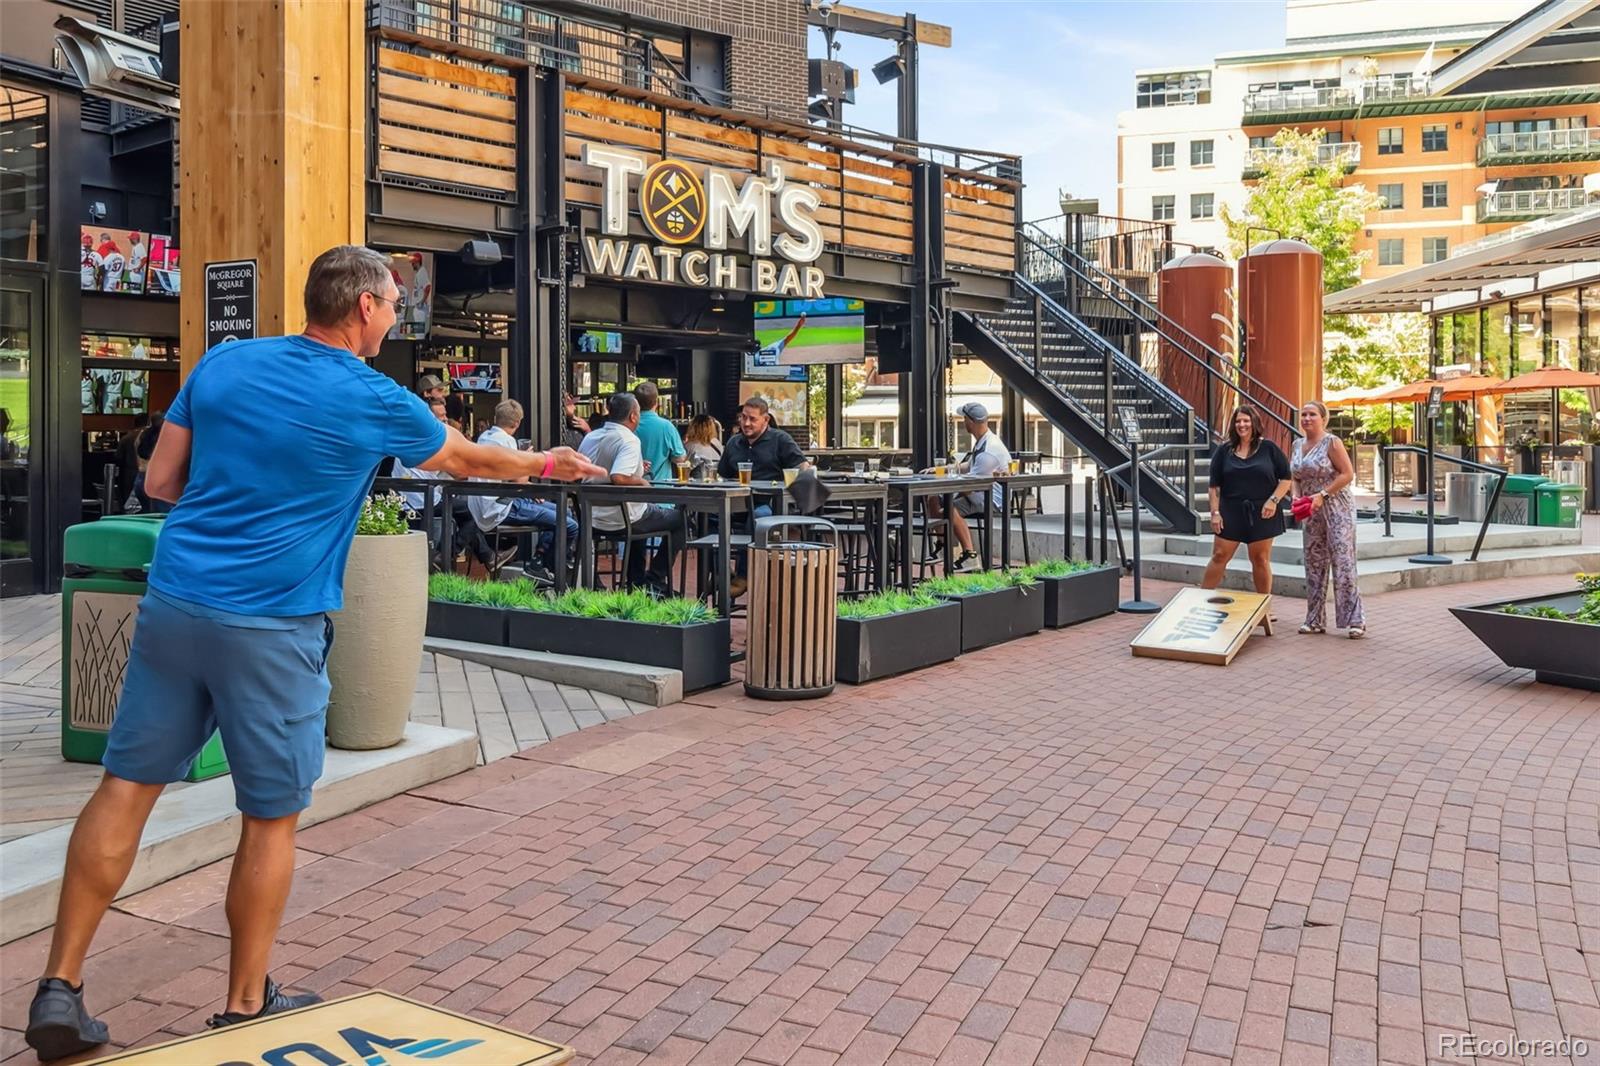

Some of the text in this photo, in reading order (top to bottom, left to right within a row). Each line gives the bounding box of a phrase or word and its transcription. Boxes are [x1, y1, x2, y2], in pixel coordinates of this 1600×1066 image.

[582, 143, 824, 262] TOM'S
[582, 236, 826, 299] WATCH BAR
[216, 280, 244, 291] SQUARE
[223, 305, 238, 317] NO
[209, 318, 252, 331] SMOKING
